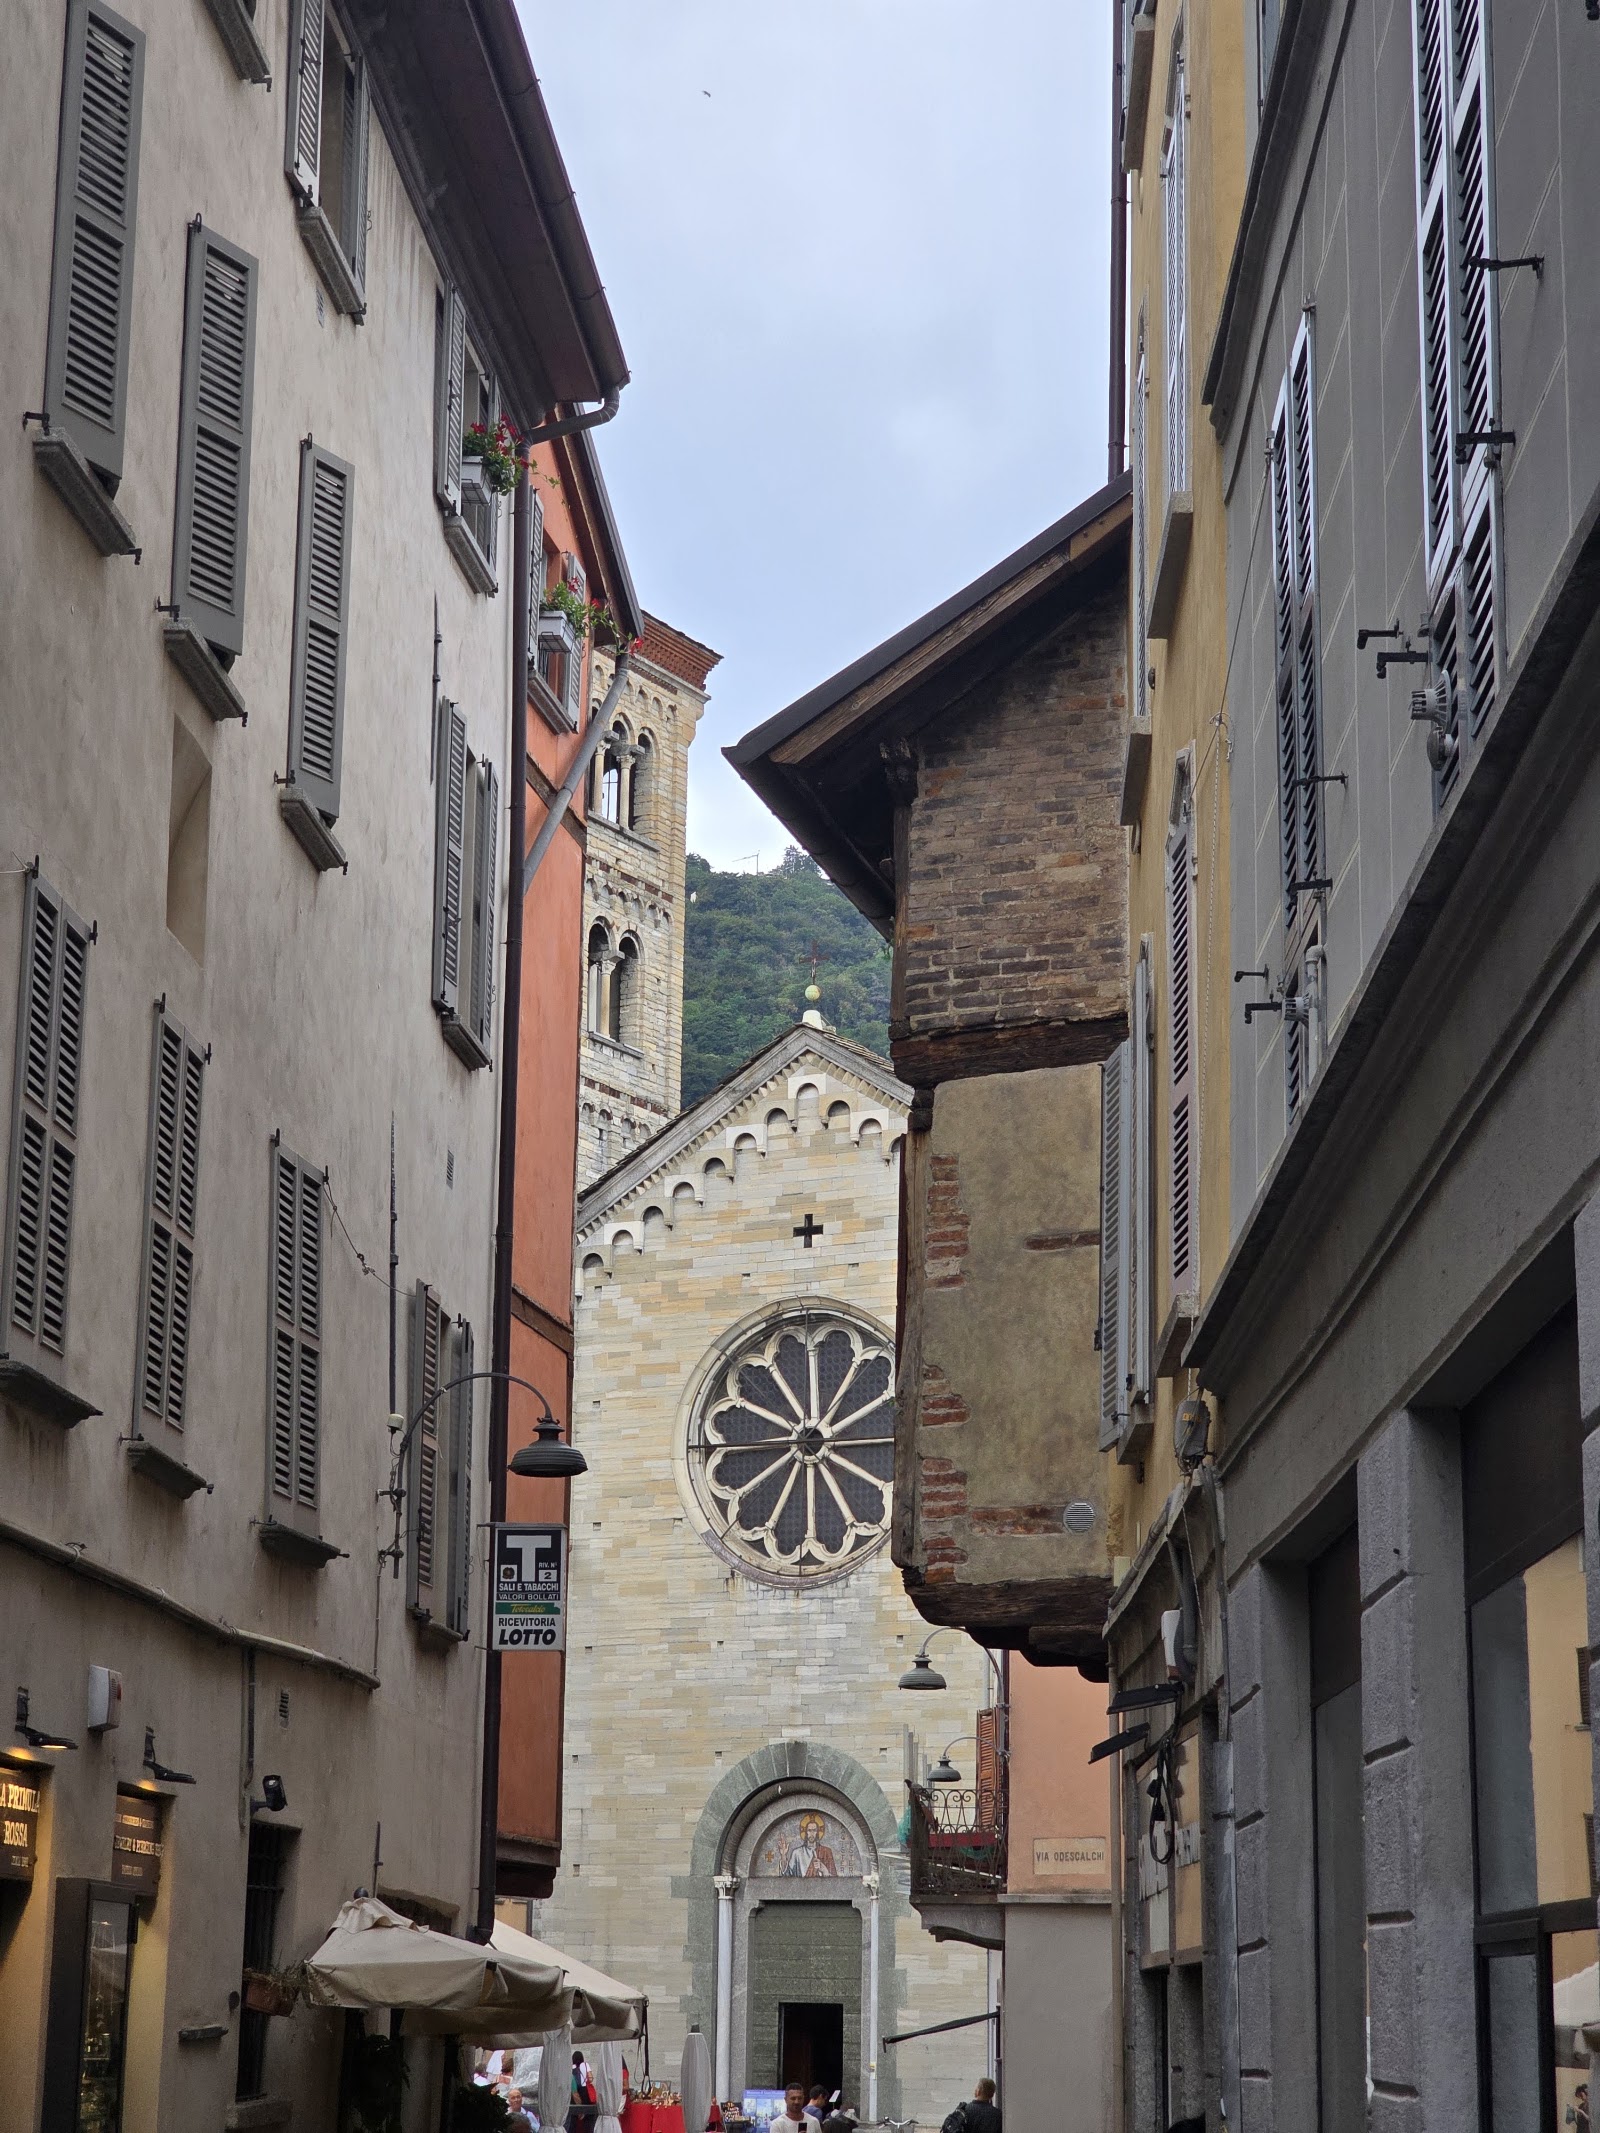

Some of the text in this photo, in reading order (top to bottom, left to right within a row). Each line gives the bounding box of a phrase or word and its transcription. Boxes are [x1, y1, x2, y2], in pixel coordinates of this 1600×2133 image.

[506, 1535, 552, 1582] T
[544, 1571, 552, 1580] 2
[499, 1583, 559, 1591] SALI E TABACCHI
[510, 1603, 546, 1614] Totocalcio
[498, 1617, 556, 1627] RICEVITORIA
[498, 1629, 557, 1645] LOTTO
[7, 1783, 40, 1813] PRIMULA
[3, 1820, 28, 1847] ROSSA
[1036, 1851, 1104, 1862] VIA ODESCALCHI
